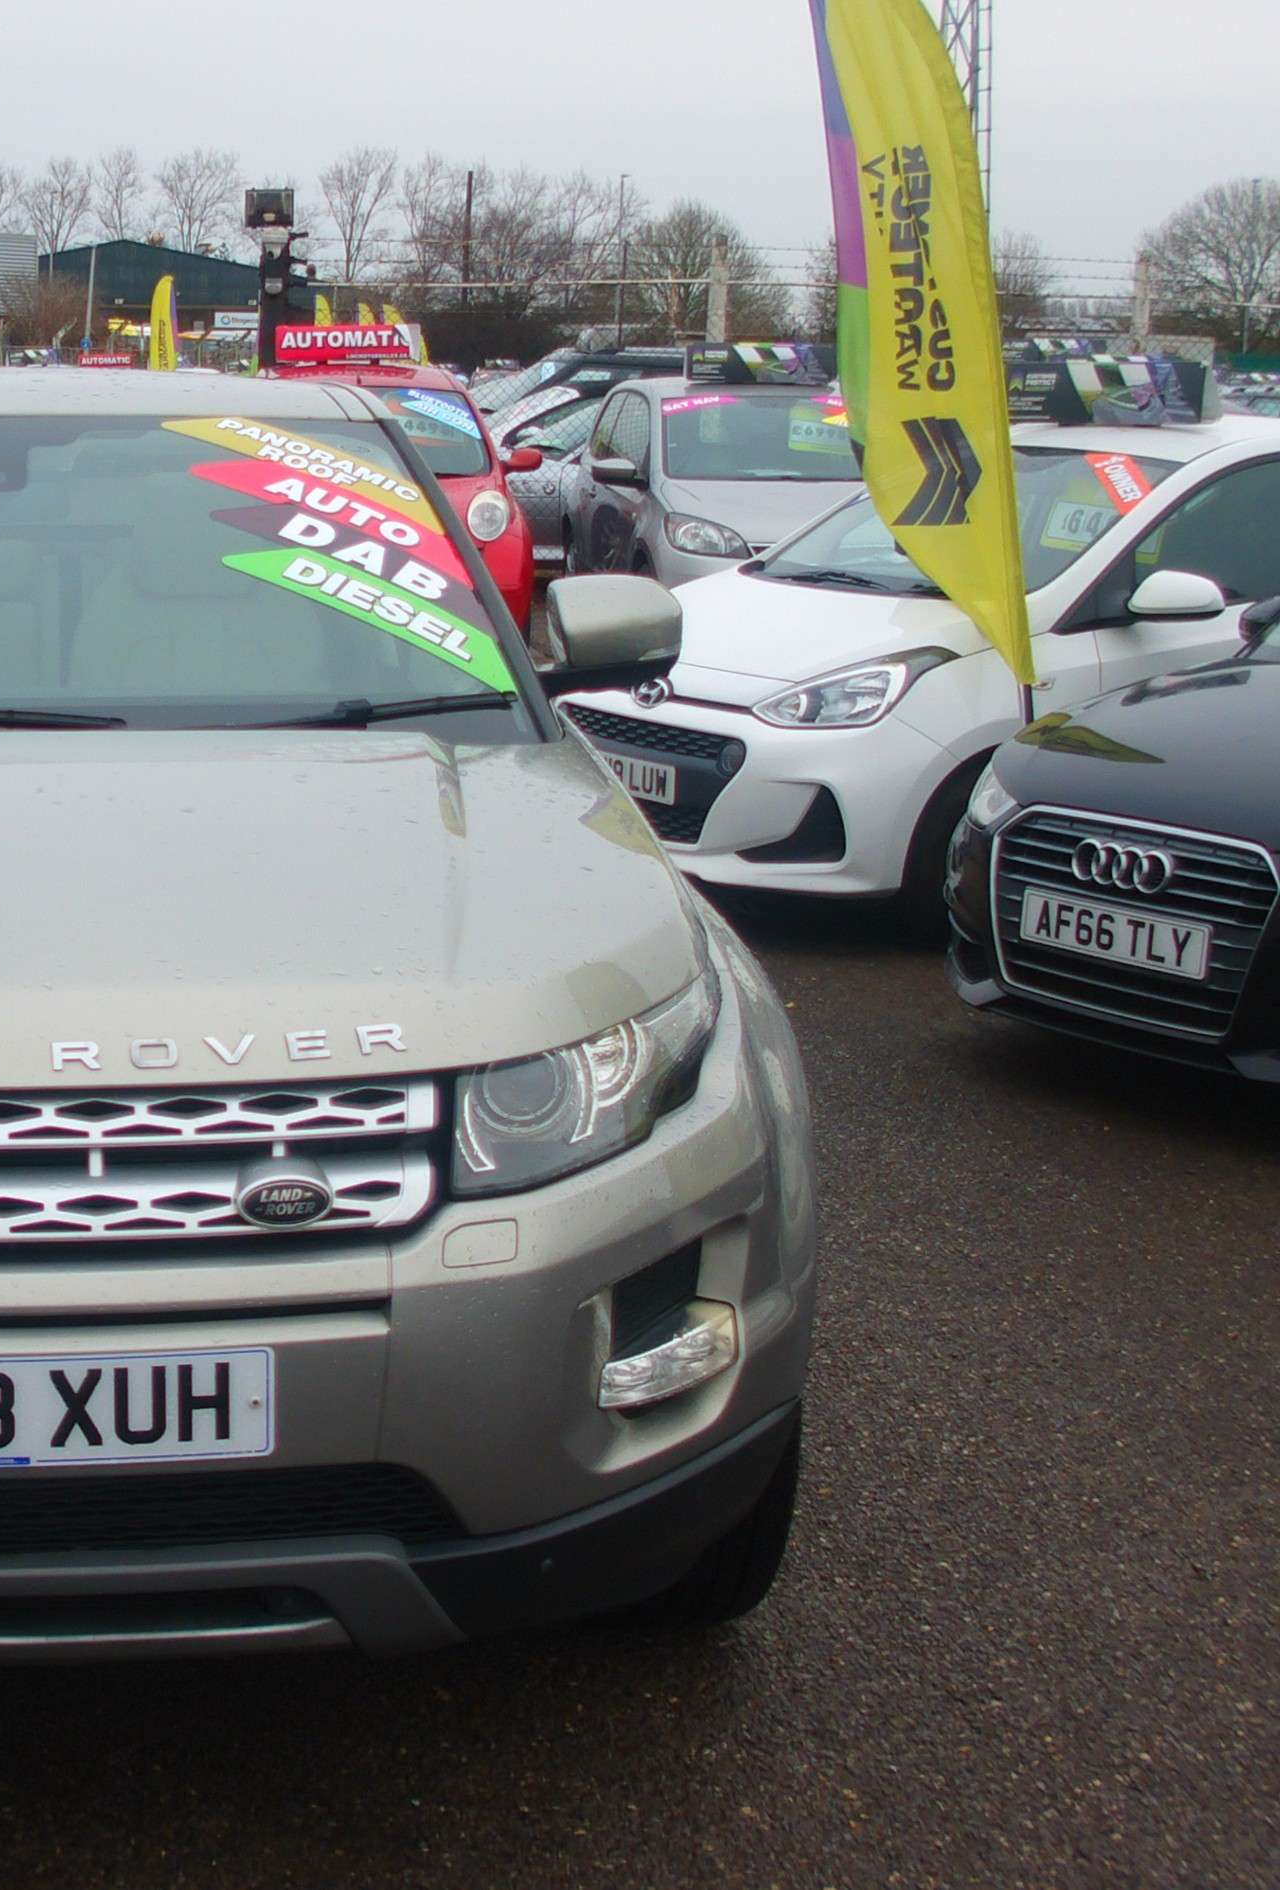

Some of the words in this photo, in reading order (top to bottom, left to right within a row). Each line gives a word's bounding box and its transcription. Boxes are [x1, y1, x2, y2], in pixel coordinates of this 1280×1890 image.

[82, 356, 130, 365] AUTOMATIC
[407, 389, 469, 418] BLUETOOTH
[663, 401, 688, 412] SAT
[217, 418, 420, 501] PANORAMIC
[257, 446, 357, 485] ROOF
[1104, 464, 1142, 502] OWNER
[263, 478, 420, 546] AUTO
[277, 513, 448, 600] DAB
[282, 557, 471, 661] DIESEL
[1035, 900, 1115, 951] AF66
[1127, 919, 1191, 967] TLY
[51, 1022, 408, 1072] ROVER
[50, 1361, 230, 1448] XUH
